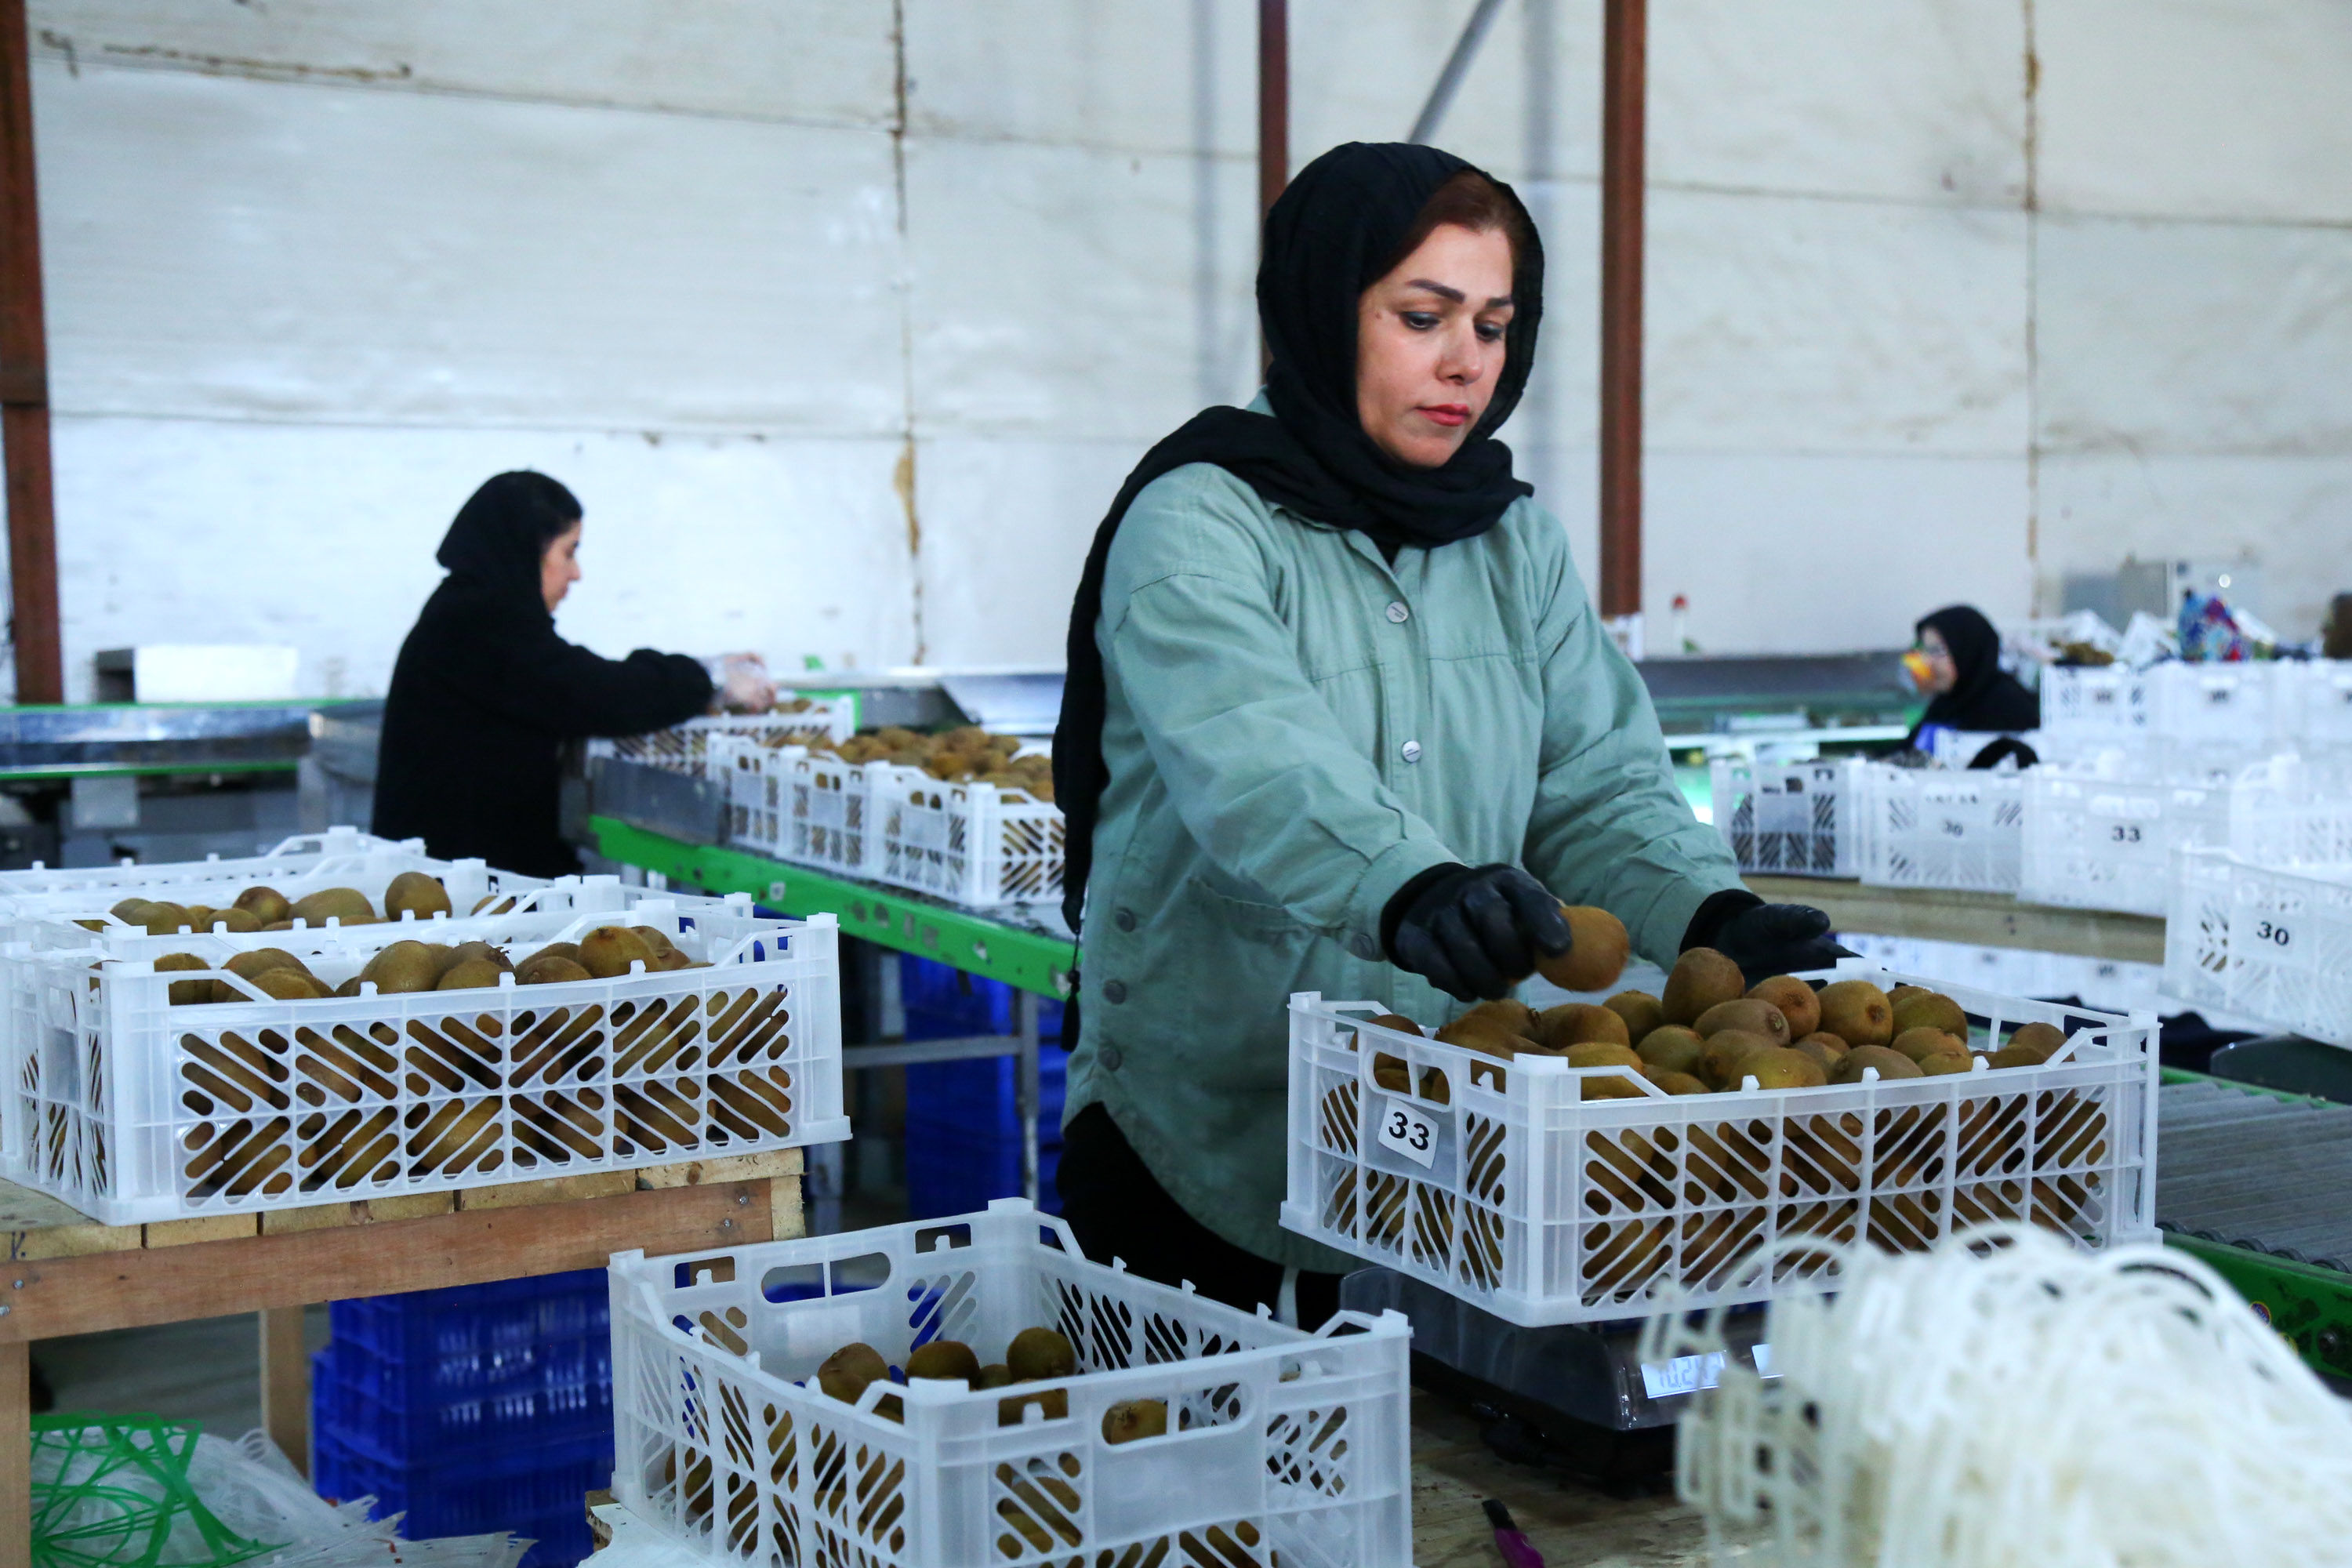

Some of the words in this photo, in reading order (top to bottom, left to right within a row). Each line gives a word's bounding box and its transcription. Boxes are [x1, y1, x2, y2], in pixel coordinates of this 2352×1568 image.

[2111, 825, 2141, 843] 33
[2256, 920, 2289, 946] 30
[1388, 1112, 1430, 1151] 33
